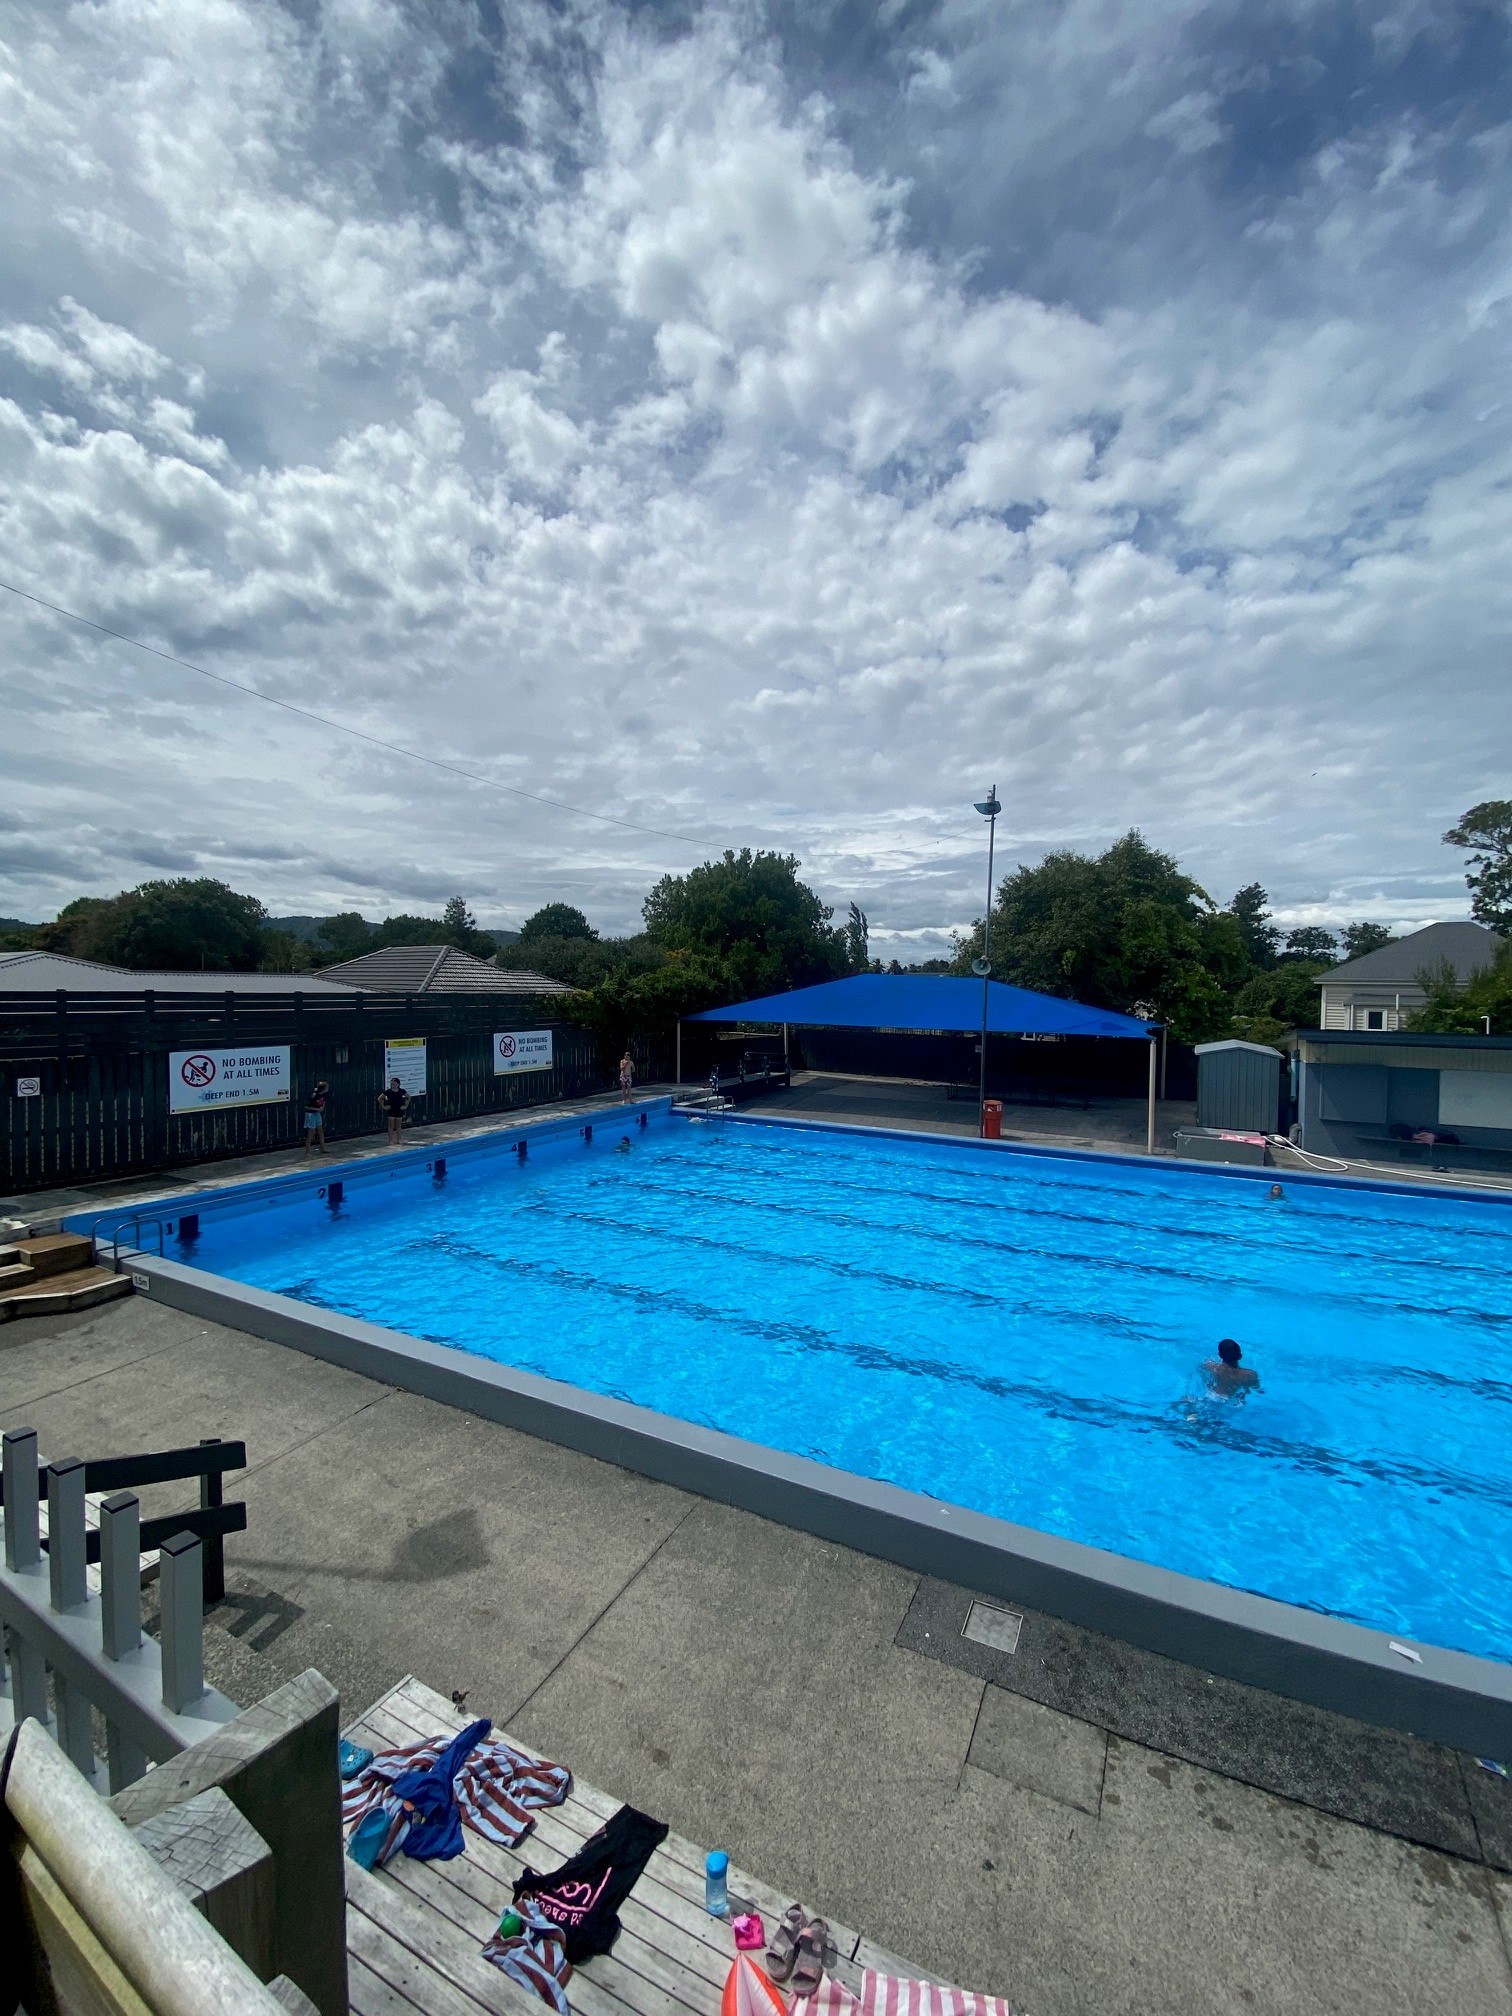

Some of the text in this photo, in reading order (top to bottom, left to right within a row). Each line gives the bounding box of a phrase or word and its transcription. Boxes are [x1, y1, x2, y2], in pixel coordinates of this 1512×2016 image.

[527, 1036, 548, 1044] BOMBING
[534, 1044, 548, 1052] TIMES
[222, 1055, 281, 1068] NO BOMBING
[222, 1066, 280, 1080] AT ALL TIMES
[205, 1088, 260, 1101] DEEP END 1.5M
[510, 1142, 518, 1152] 4
[425, 1162, 433, 1173] 3
[317, 1187, 327, 1200] 2
[166, 1222, 174, 1236] 1
[133, 1275, 149, 1287] 1.5m
